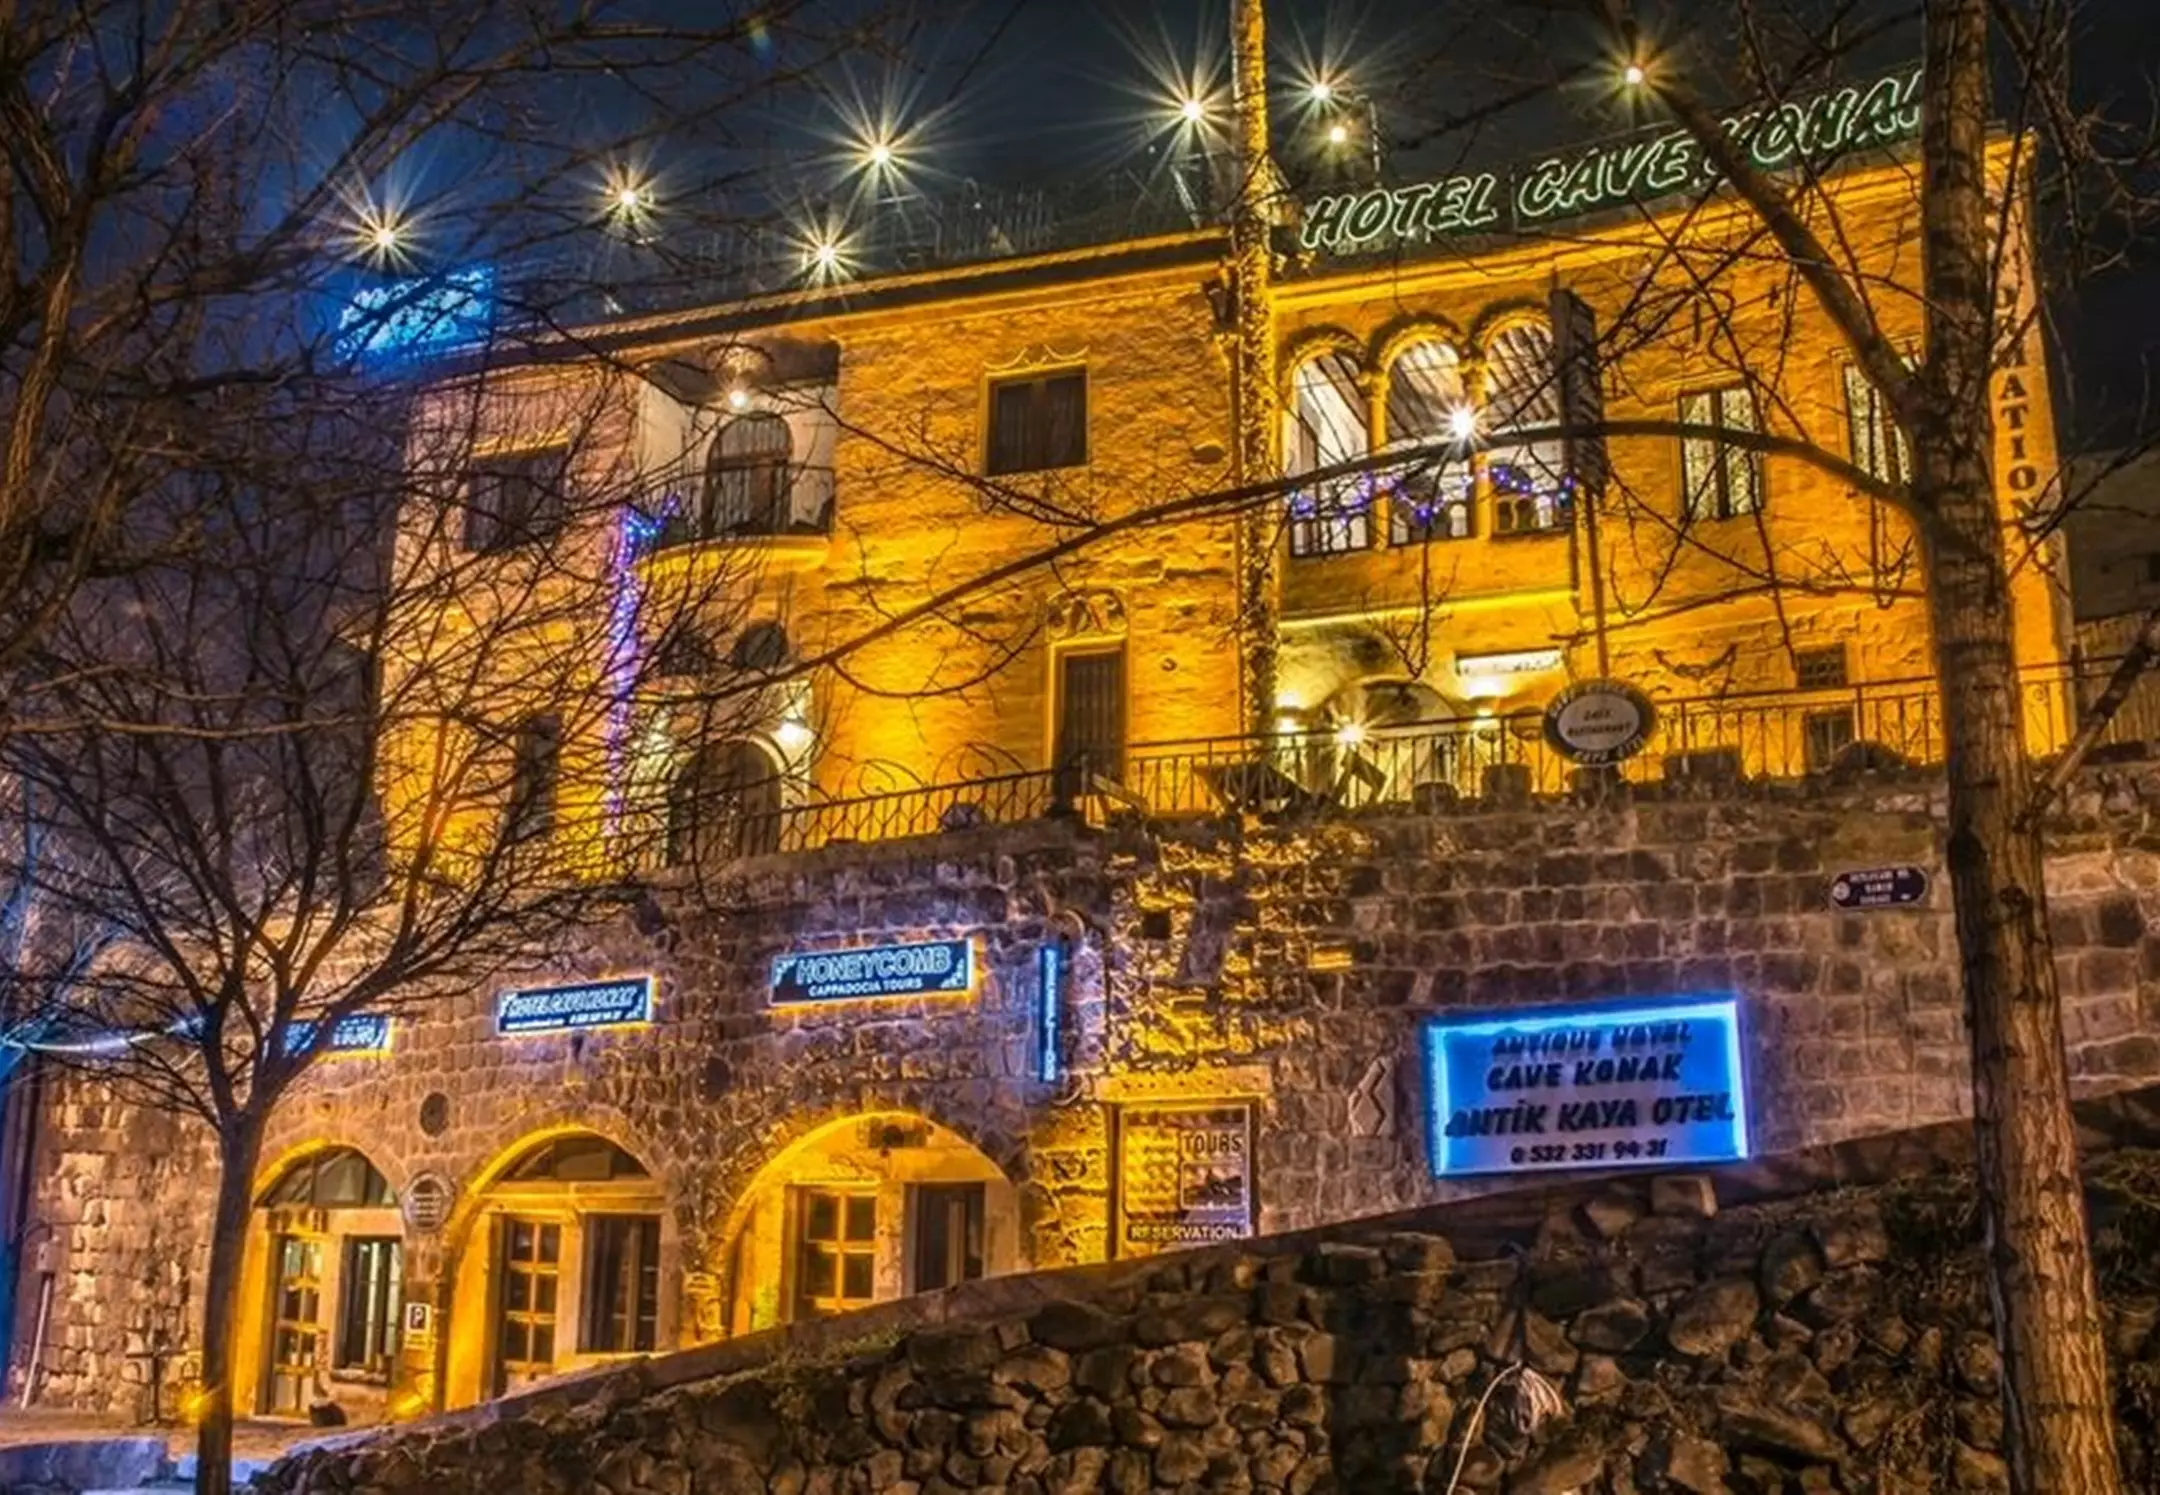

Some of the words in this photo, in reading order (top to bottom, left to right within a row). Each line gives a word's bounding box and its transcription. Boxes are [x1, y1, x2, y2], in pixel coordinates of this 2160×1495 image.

[1301, 173, 1498, 249] HOTEL
[1517, 128, 1698, 217] CAVE
[796, 945, 952, 985] HONEYCOMB
[808, 980, 882, 997] CAPPADOCIA
[884, 977, 923, 992] TOURS
[1487, 1063, 1563, 1092] CAVE
[1574, 1053, 1685, 1086] KONAK
[1557, 1100, 1638, 1132] KAYA
[1652, 1092, 1735, 1125] OTEL
[1184, 1133, 1242, 1152] TOURS
[1131, 1224, 1237, 1241] RESERVATION
